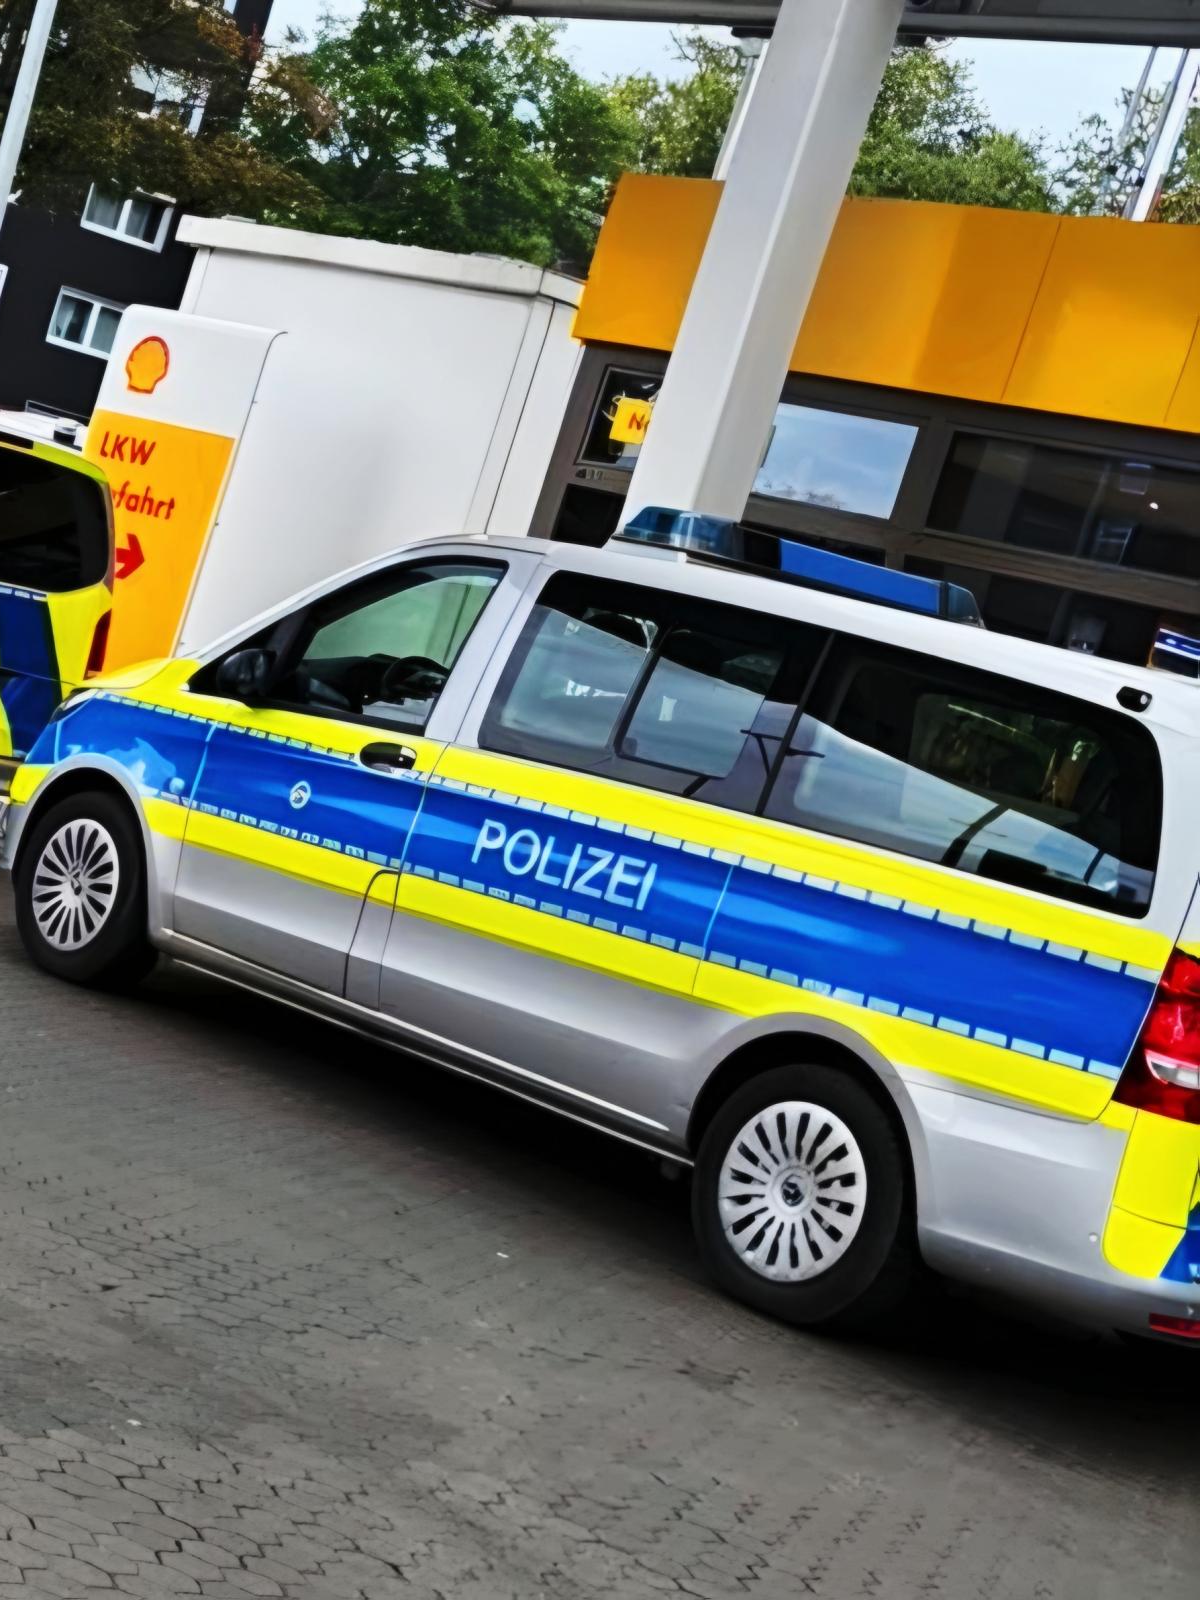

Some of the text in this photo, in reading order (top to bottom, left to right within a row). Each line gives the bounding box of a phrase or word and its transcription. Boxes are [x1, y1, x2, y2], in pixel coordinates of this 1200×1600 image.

[100, 431, 156, 466] LKW
[111, 480, 175, 520] fahrt
[471, 818, 658, 911] POLIZEI
